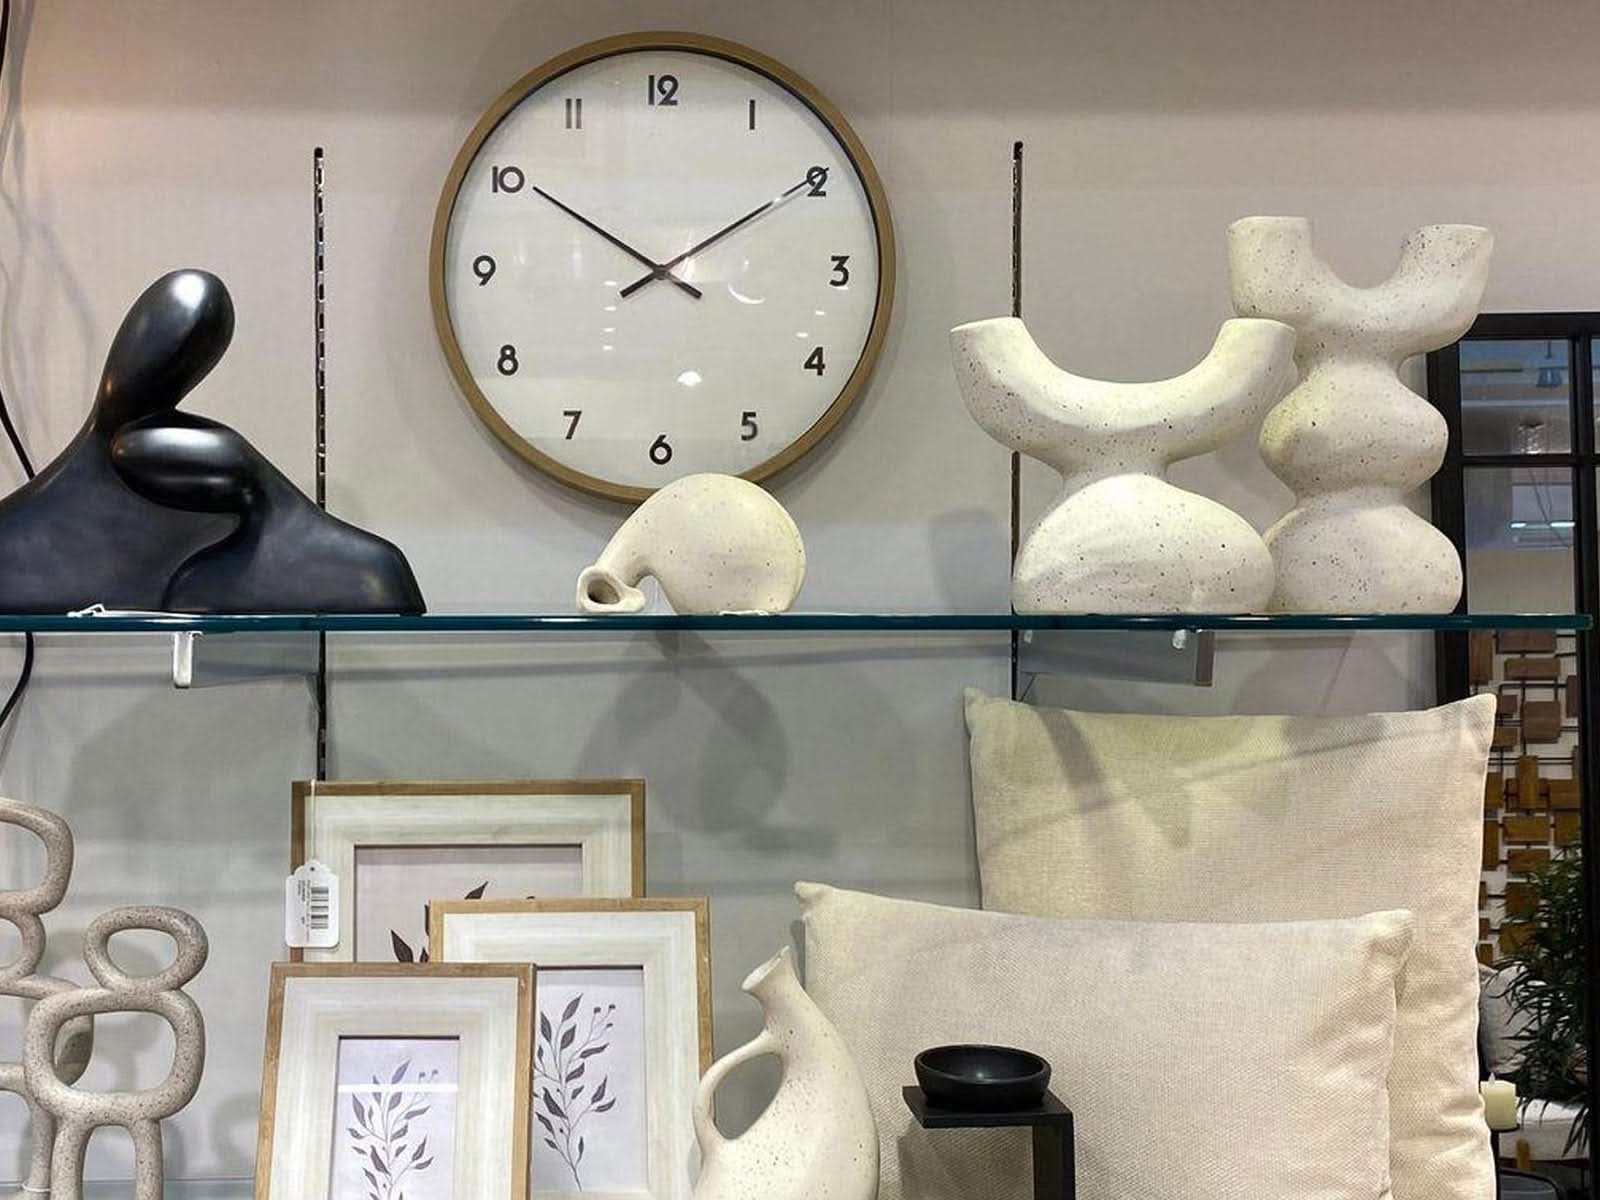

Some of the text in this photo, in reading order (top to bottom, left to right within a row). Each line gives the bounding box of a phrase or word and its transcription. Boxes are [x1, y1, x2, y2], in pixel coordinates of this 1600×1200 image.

[647, 74, 679, 106] 12
[565, 98, 583, 129] 11
[749, 99, 756, 131] 1
[491, 165, 525, 194] 10
[806, 166, 828, 198] 2
[472, 255, 497, 286] 9
[829, 255, 851, 287] 3
[497, 344, 520, 377] 8
[803, 346, 826, 377] 4
[562, 410, 583, 440] 7
[740, 411, 760, 442] 5
[649, 434, 673, 466] 6
